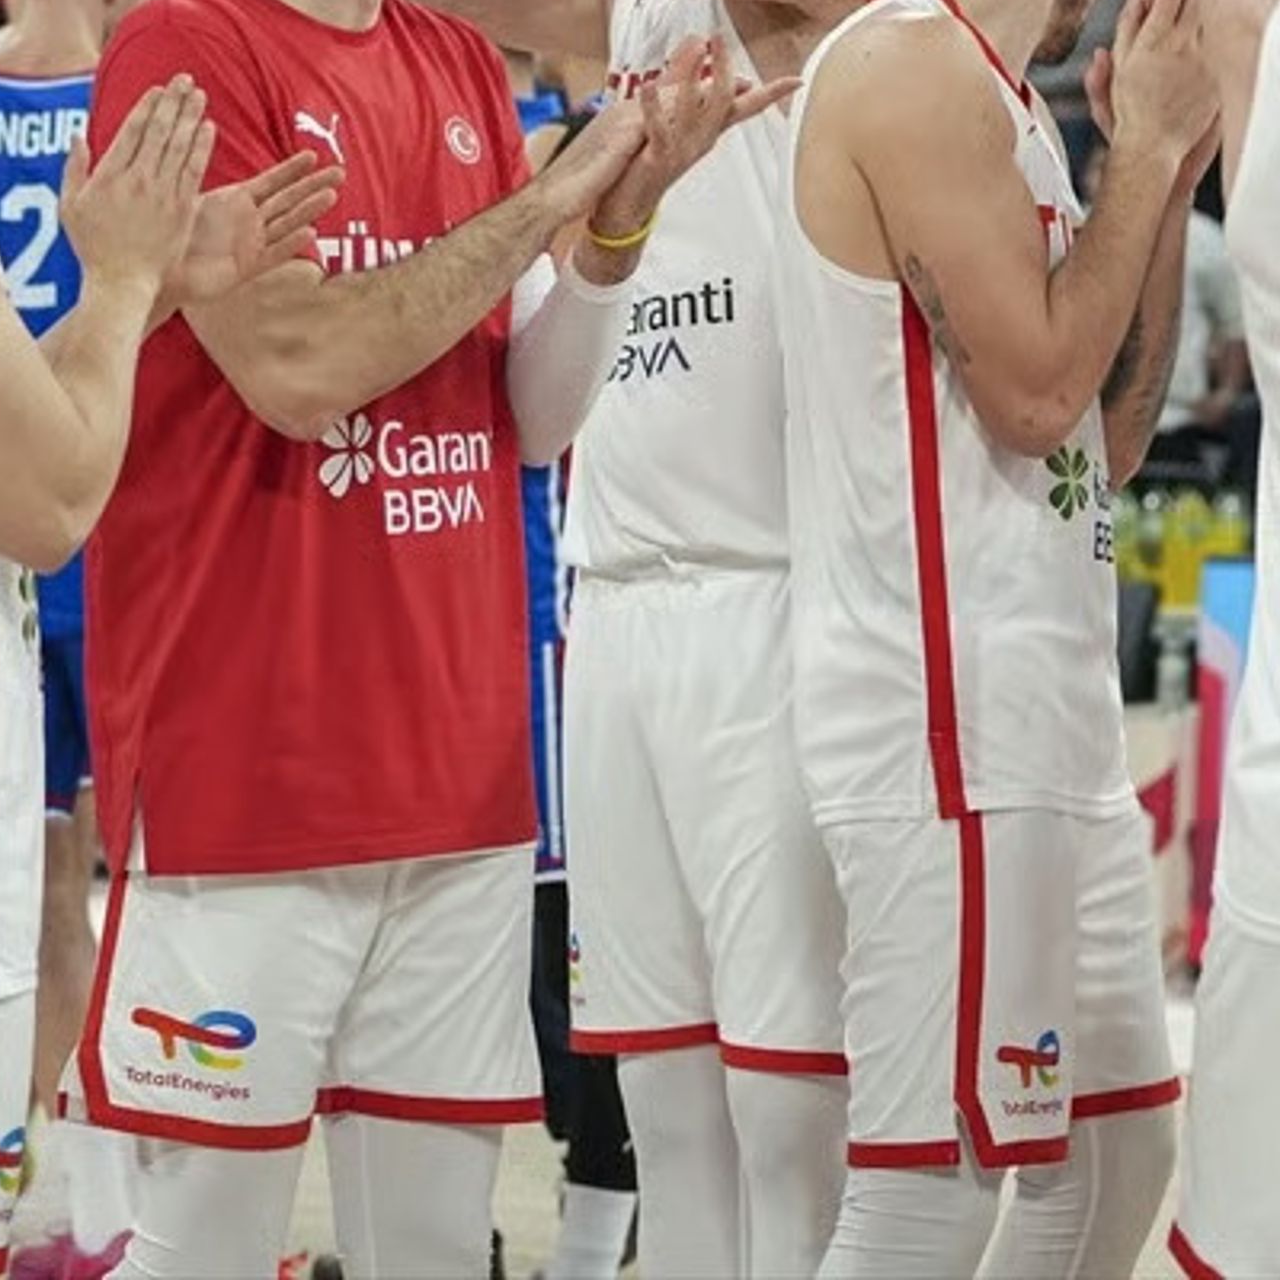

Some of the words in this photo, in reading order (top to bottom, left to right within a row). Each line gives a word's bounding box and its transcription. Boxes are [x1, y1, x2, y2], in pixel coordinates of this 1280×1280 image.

[0, 183, 59, 308] 2
[607, 337, 692, 382] BVA
[378, 420, 493, 478] Garan
[384, 481, 484, 535] BBVA
[125, 1066, 251, 1100] TotalEnergies
